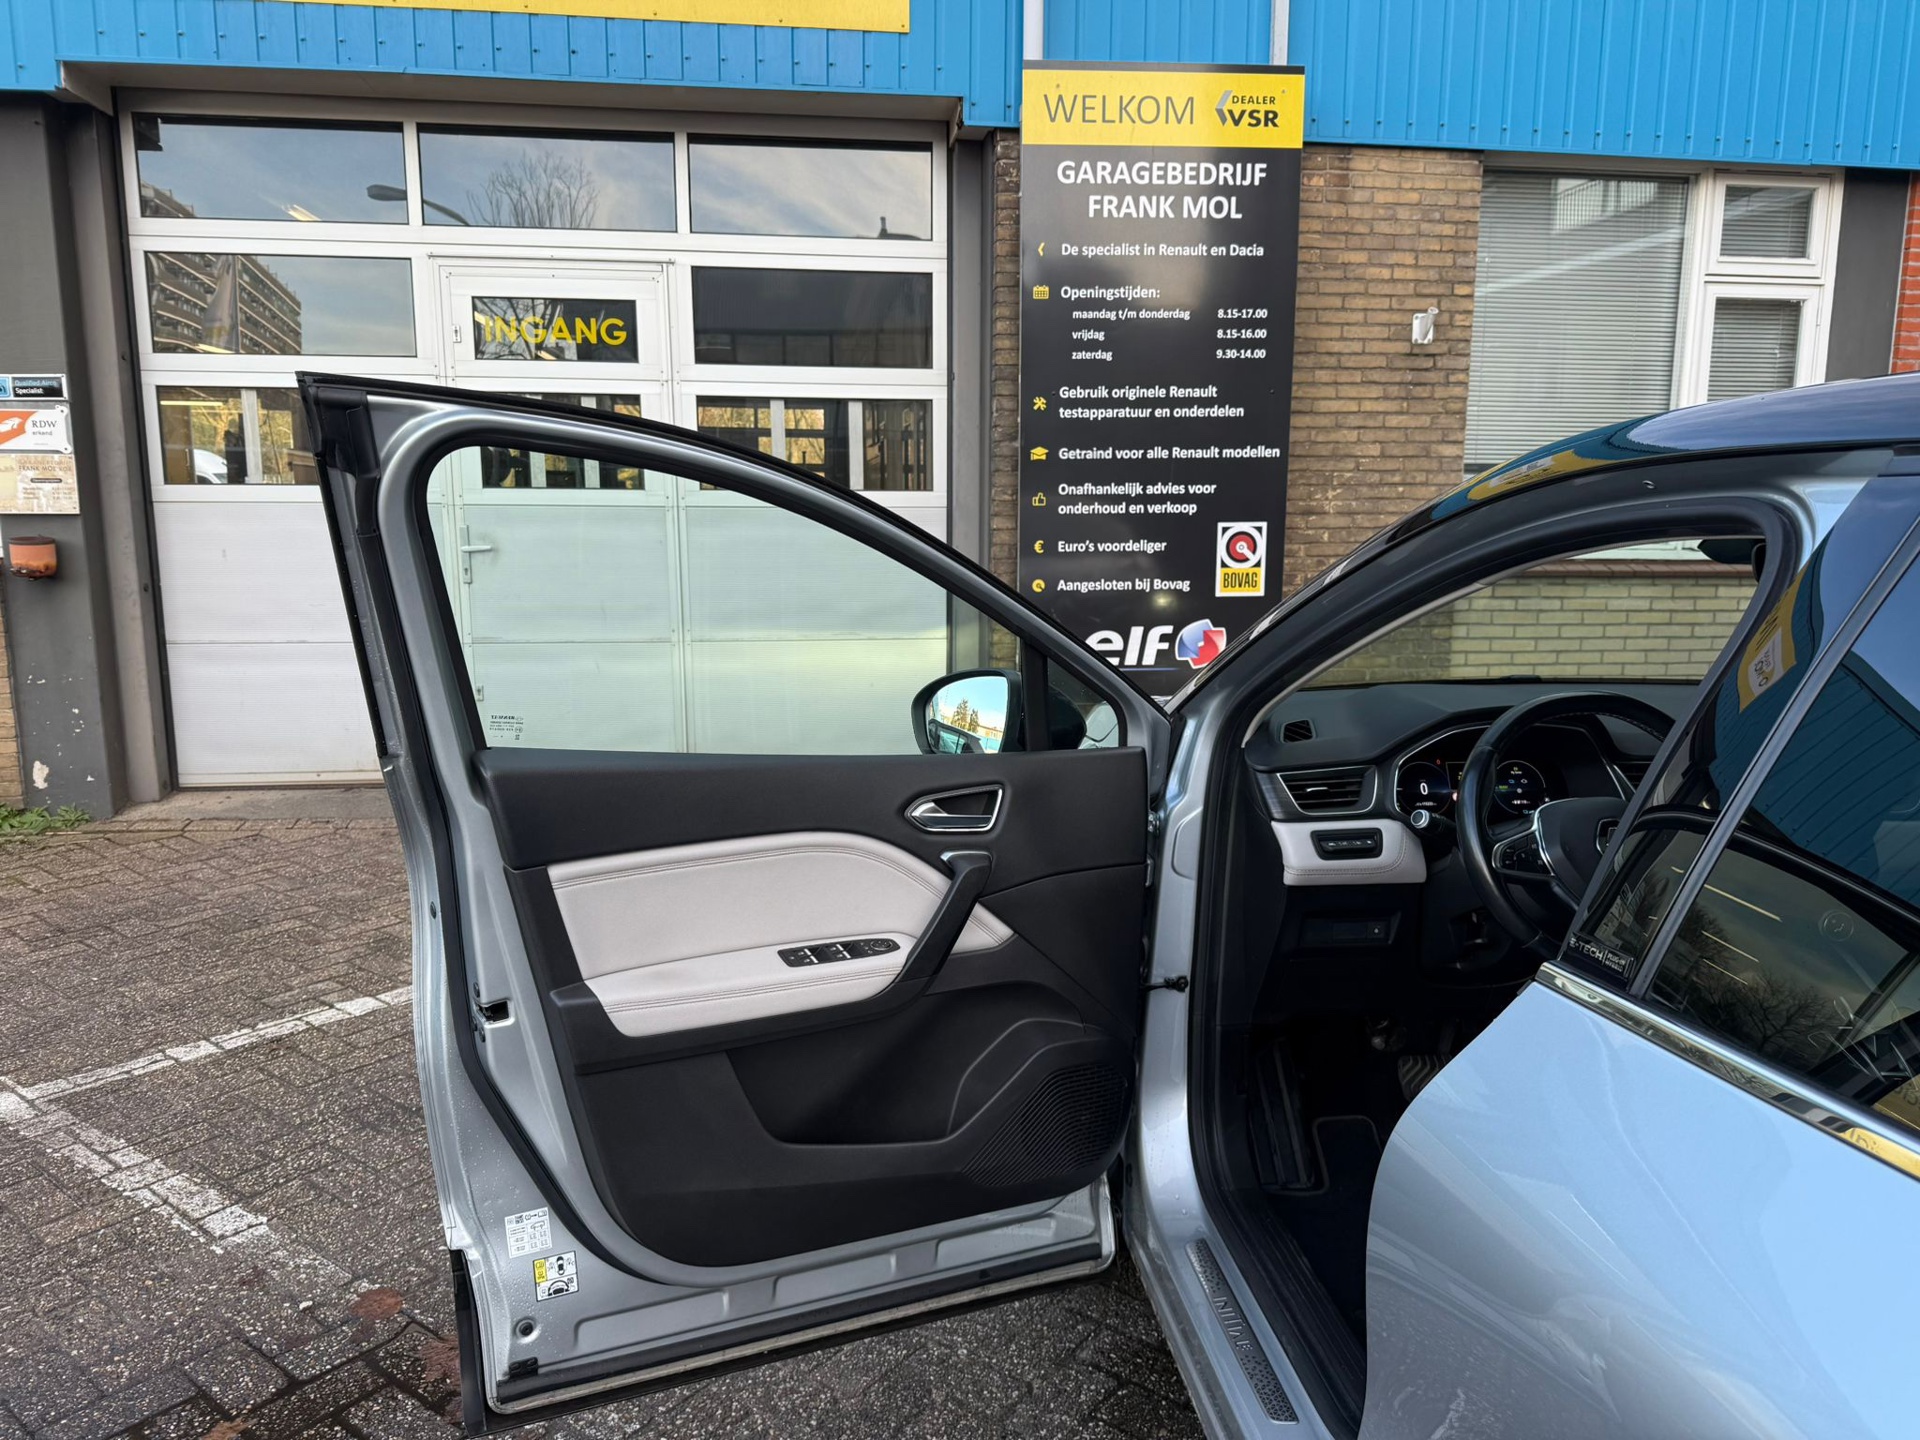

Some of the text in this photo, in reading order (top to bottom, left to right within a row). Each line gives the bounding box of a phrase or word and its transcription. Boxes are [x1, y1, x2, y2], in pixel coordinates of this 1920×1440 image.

[1232, 94, 1276, 105] DEALER
[1044, 94, 1194, 125] WELKOM
[1228, 109, 1279, 128] VSR
[1057, 161, 1267, 186] GARAGEBEDRIJF
[1088, 196, 1242, 219] FRANK MOL
[1062, 244, 1264, 258] De specialist in Renault en Dacia
[1061, 286, 1160, 301] Openingstijden:
[1072, 308, 1268, 320] maandag t/m donderdag 8.15-17.00
[484, 315, 628, 346] INGANG
[1072, 329, 1267, 340] vrijdag 8.15-16.00
[1072, 349, 1266, 361] zaterdag 9.30-14.00
[1060, 386, 1218, 400] Gebruik originele Renault
[1059, 405, 1244, 420] testapparatuur en onderdelen
[32, 420, 57, 428] RDW
[1058, 446, 1280, 460] Getraind voor alle Renault modellen
[1058, 482, 1216, 496] Onafhankelijk advies voor
[1058, 502, 1198, 516] onderhoud en verkoop
[1098, 540, 1167, 554] voordeliger
[1058, 579, 1190, 592] Aangesloten bij Bovag
[1223, 572, 1258, 588] BOVAG
[1085, 625, 1174, 666] elf
[1569, 937, 1604, 961] E-TECH
